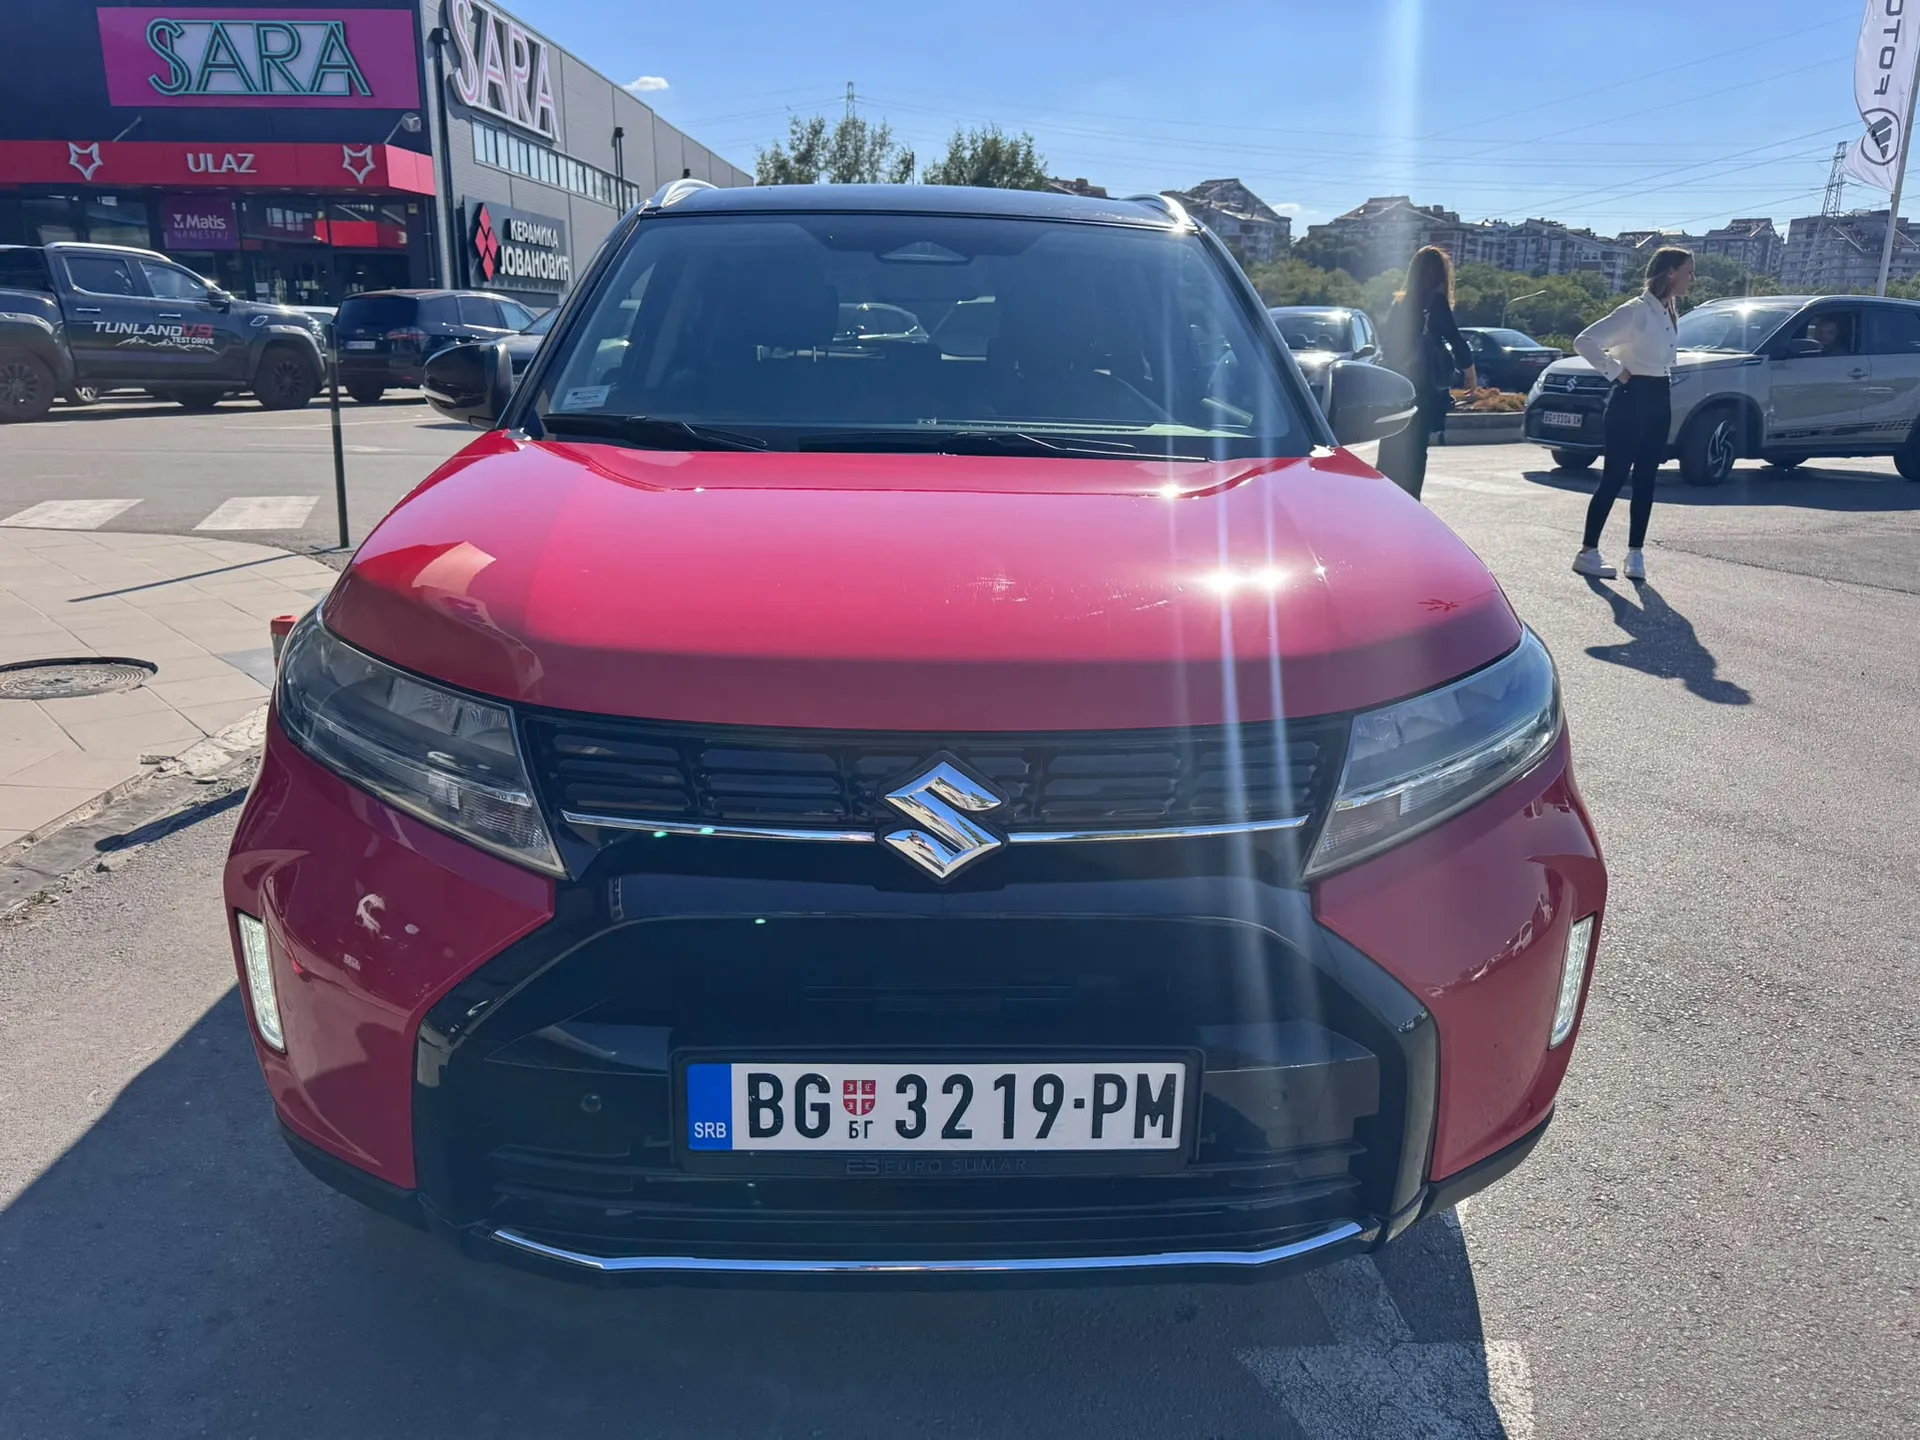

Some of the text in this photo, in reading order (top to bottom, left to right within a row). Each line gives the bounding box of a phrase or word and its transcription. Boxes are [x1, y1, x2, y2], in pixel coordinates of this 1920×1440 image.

[146, 18, 372, 97] SARA
[446, 0, 561, 143] SARA
[187, 153, 258, 174] ULAZ
[186, 213, 227, 230] Matis
[509, 218, 559, 248] КЕРАМИКА
[500, 245, 570, 281] ЈОВАНОВИЋ
[172, 336, 215, 345] TEST DRIVE
[747, 1072, 832, 1139] BG
[694, 1122, 727, 1138] SRB
[848, 1120, 874, 1139] БГ
[884, 1158, 943, 1174] EURO
[952, 1157, 1027, 1173] SUMAR
